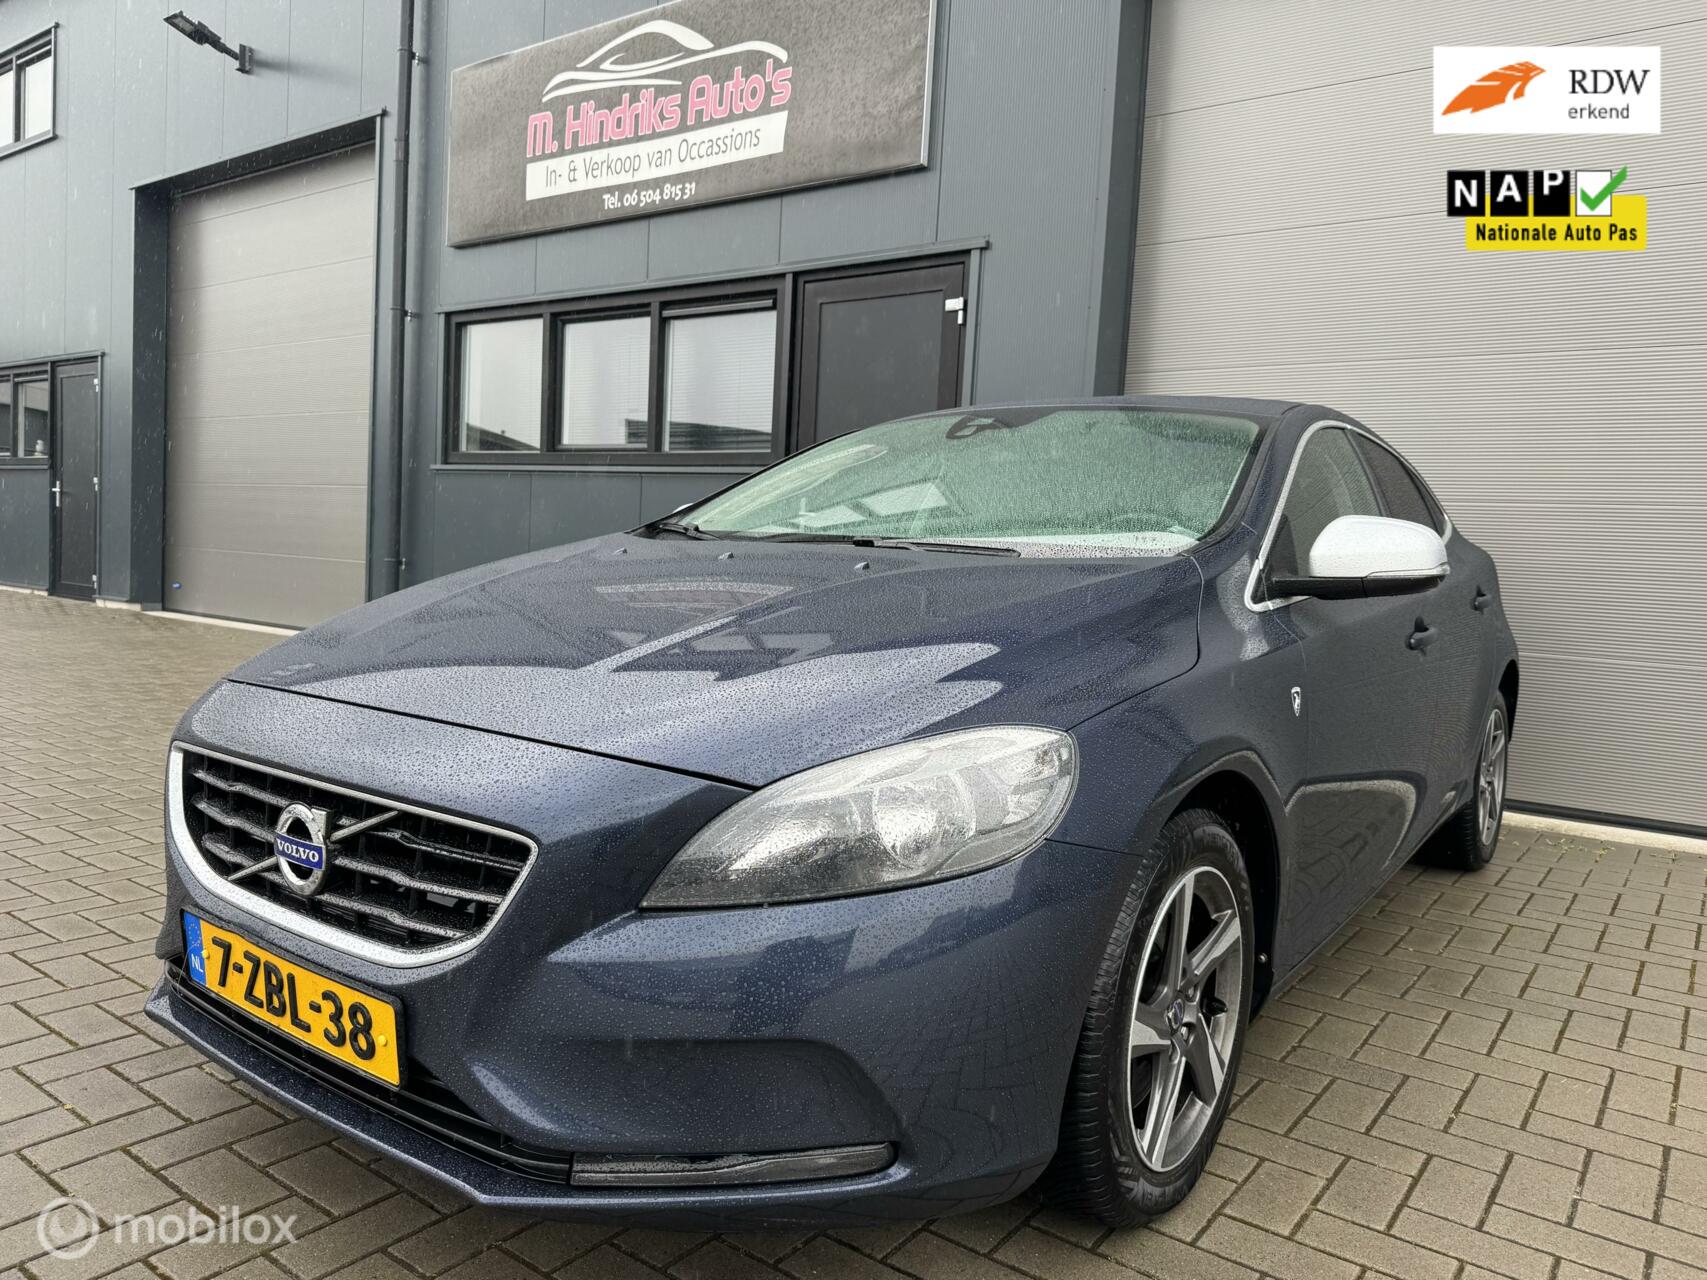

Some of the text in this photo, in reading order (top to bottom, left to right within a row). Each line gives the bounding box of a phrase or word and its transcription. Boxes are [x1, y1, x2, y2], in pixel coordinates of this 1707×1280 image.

[526, 58, 793, 158] M. Hindriks Auto's
[545, 128, 761, 188] In- & Verkoop van Occassions
[602, 191, 621, 210] Tel.
[276, 838, 319, 863] VOLVO
[190, 953, 204, 973] NL
[211, 935, 376, 1061] 7-ZBL-38
